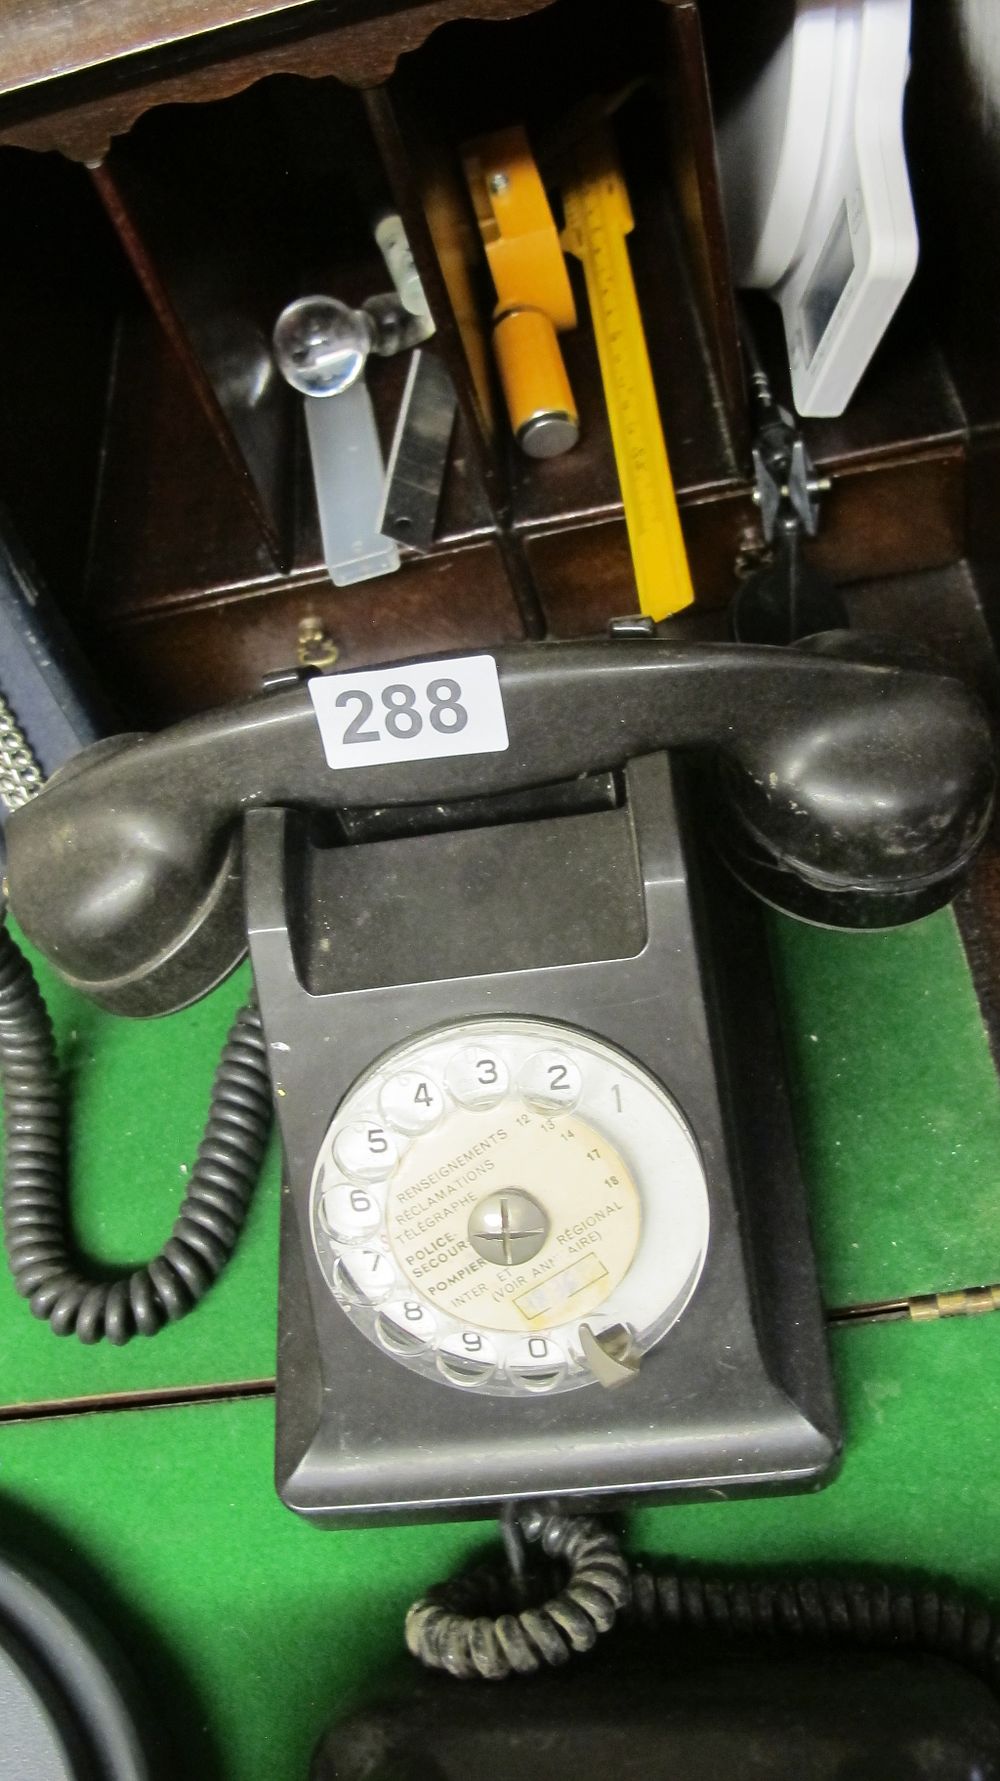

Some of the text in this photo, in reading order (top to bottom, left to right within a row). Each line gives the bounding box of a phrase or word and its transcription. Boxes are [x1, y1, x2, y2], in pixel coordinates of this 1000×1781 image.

[335, 678, 468, 744] 288
[476, 1059, 498, 1084] 3
[547, 1064, 571, 1091] 2
[414, 1083, 433, 1107] 4
[611, 1084, 622, 1113] 1
[367, 1128, 389, 1154] 5
[394, 1119, 556, 1226] RÉCLAMATIONS 13
[396, 1113, 532, 1204] RENSEIGNEMENTS 12
[350, 1188, 371, 1213] 6
[394, 1191, 479, 1245] TÉLÉGRAPHE
[560, 1129, 576, 1142] 14
[412, 1239, 470, 1279] SECOUR
[586, 1148, 601, 1161] 17
[428, 1175, 620, 1296] POMPIER 18
[362, 1249, 381, 1272] 7
[450, 1200, 624, 1308] INTER ET RÉGIONAL
[491, 1275, 528, 1304] (VOIR
[403, 1301, 424, 1322] 8
[462, 1331, 483, 1353] 9
[528, 1338, 548, 1358] 0
